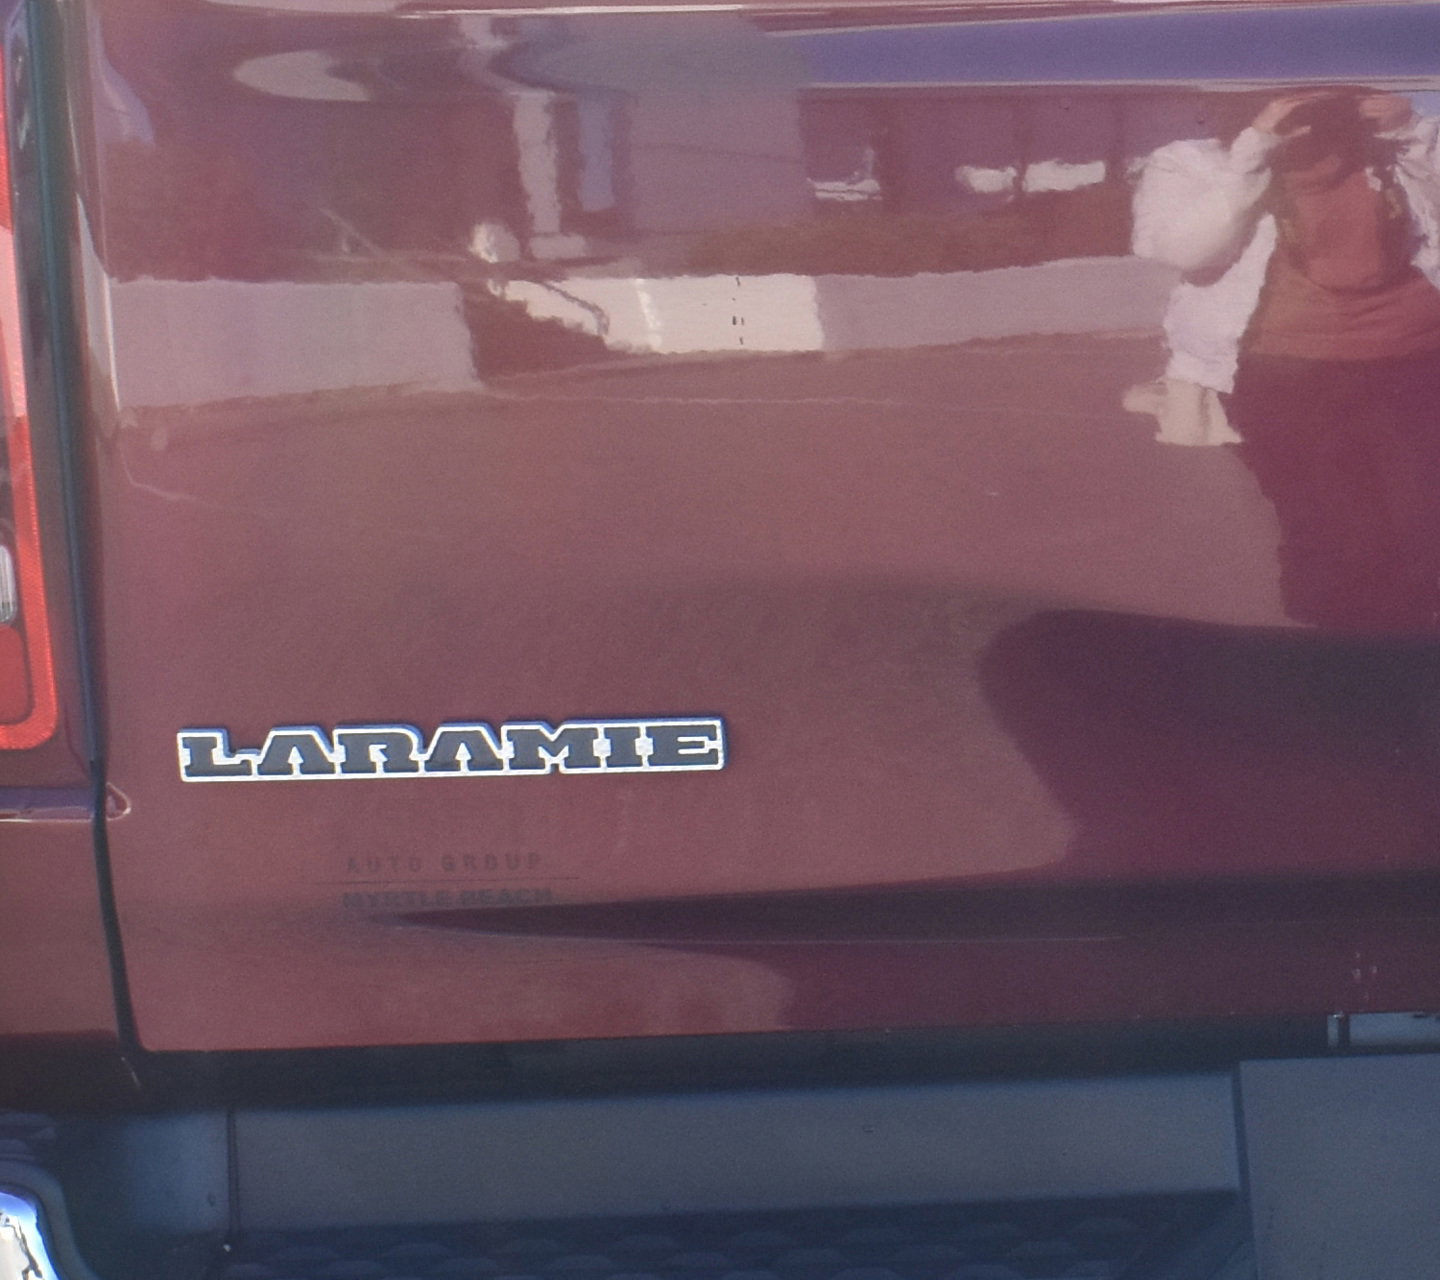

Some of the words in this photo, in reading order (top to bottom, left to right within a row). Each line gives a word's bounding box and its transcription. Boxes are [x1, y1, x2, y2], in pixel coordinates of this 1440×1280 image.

[176, 719, 725, 782] LARAMIE
[346, 855, 422, 874] AUTO
[440, 852, 542, 872] GROUP
[458, 887, 554, 907] BEACH
